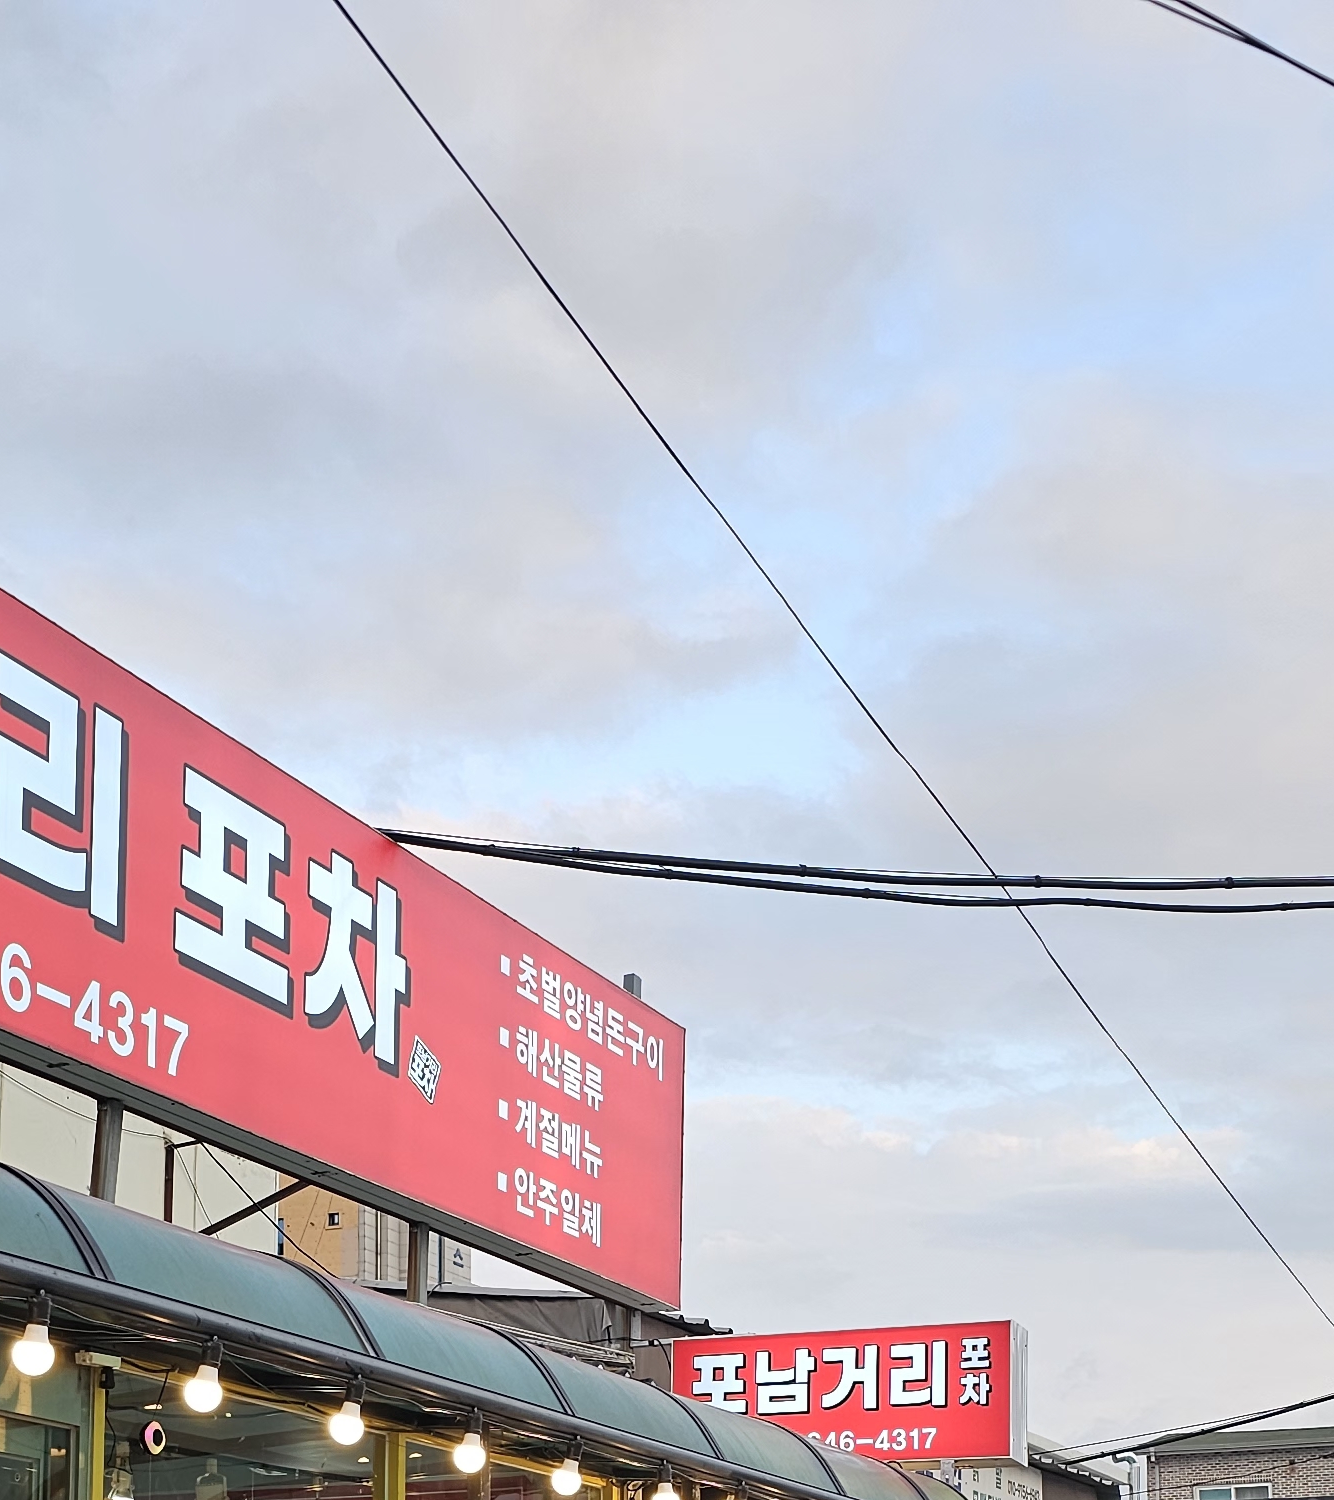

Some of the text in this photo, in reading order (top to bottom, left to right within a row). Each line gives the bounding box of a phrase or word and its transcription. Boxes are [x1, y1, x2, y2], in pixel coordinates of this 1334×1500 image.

[172, 764, 413, 1078] 포차
[516, 953, 664, 1082] 초벌양념돈구이
[515, 1024, 604, 1112] 해산물류
[514, 1098, 603, 1179] 계절메뉴
[513, 1166, 602, 1248] 안주일체
[691, 1339, 949, 1416] 포남거리
[959, 1336, 992, 1406] 포차
